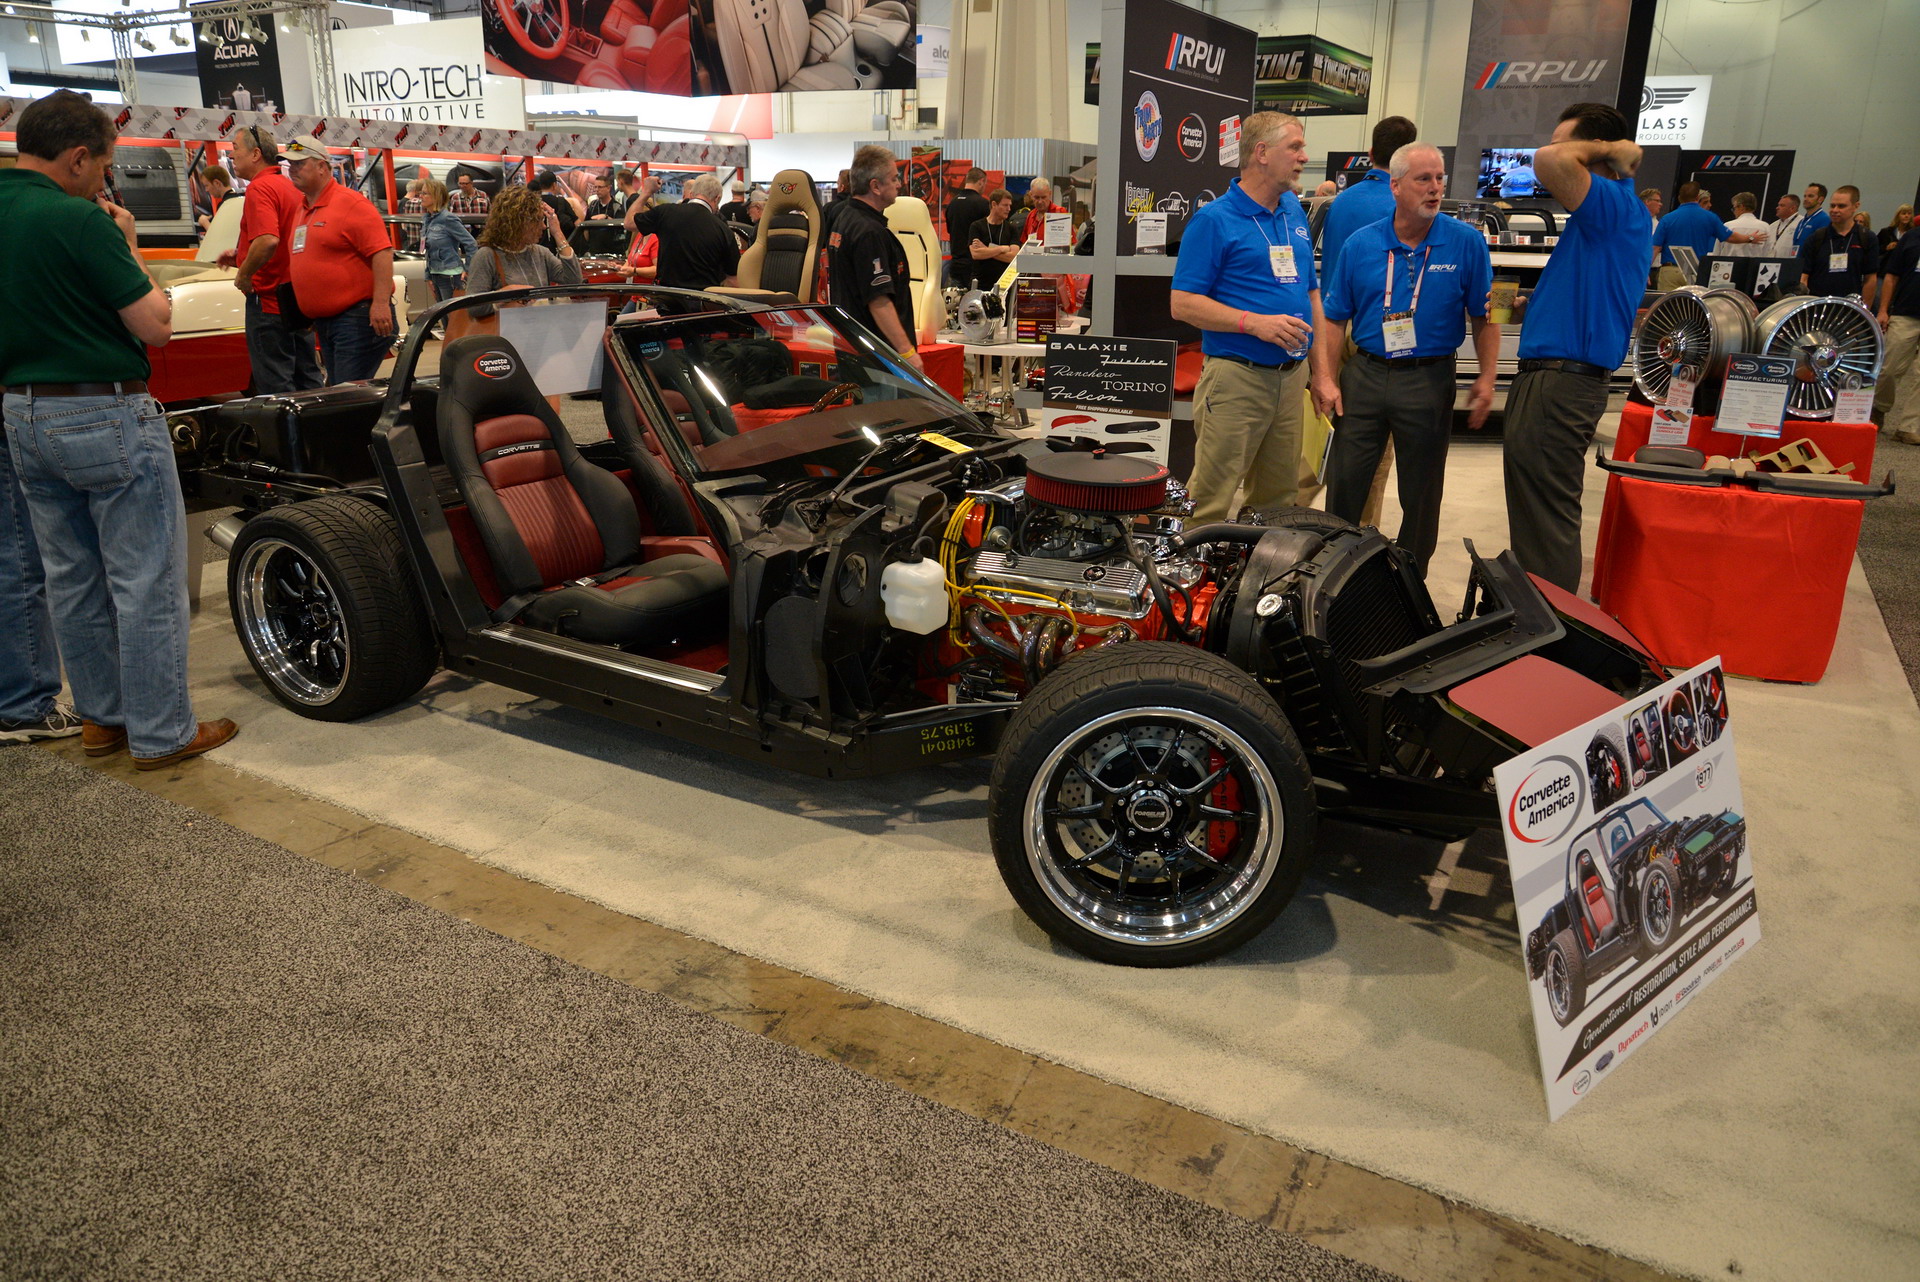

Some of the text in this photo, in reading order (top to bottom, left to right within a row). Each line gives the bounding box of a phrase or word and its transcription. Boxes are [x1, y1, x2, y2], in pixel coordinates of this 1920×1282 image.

[214, 43, 258, 60] ACURA
[1178, 35, 1226, 76] RPUI
[1500, 59, 1609, 83] RPUI
[344, 64, 483, 104] INTRO-TECH
[350, 103, 485, 122] AUTOMOTIVE
[1181, 125, 1203, 138] Corvette
[1641, 117, 1689, 130] LASS
[1182, 137, 1203, 148] America
[1638, 133, 1687, 141] RODUCTS
[1715, 154, 1775, 168] RPUI
[1050, 342, 1128, 352] GALAXIE
[479, 358, 508, 367] Corvette
[484, 363, 511, 372] America
[1100, 354, 1168, 366] Fairlane
[1050, 364, 1122, 379] Ranchero
[1729, 374, 1788, 384] MANUFACTURING
[1048, 385, 1123, 402] Falcon
[1101, 380, 1167, 393] TORINO
[497, 443, 540, 456] CORVETTE
[920, 722, 974, 740] 3.19.75
[920, 736, 975, 755] 348041
[1696, 766, 1711, 786] 1977
[1518, 773, 1571, 813] Corvette
[1527, 791, 1576, 829] America
[1582, 1002, 1626, 1050] Generations
[1633, 959, 1679, 1006] RESTORATION,
[1679, 942, 1697, 968] STYLE
[1697, 931, 1711, 953] AND
[1711, 896, 1753, 941] PERFORMANCE
[1617, 1021, 1649, 1054] Dynatech
